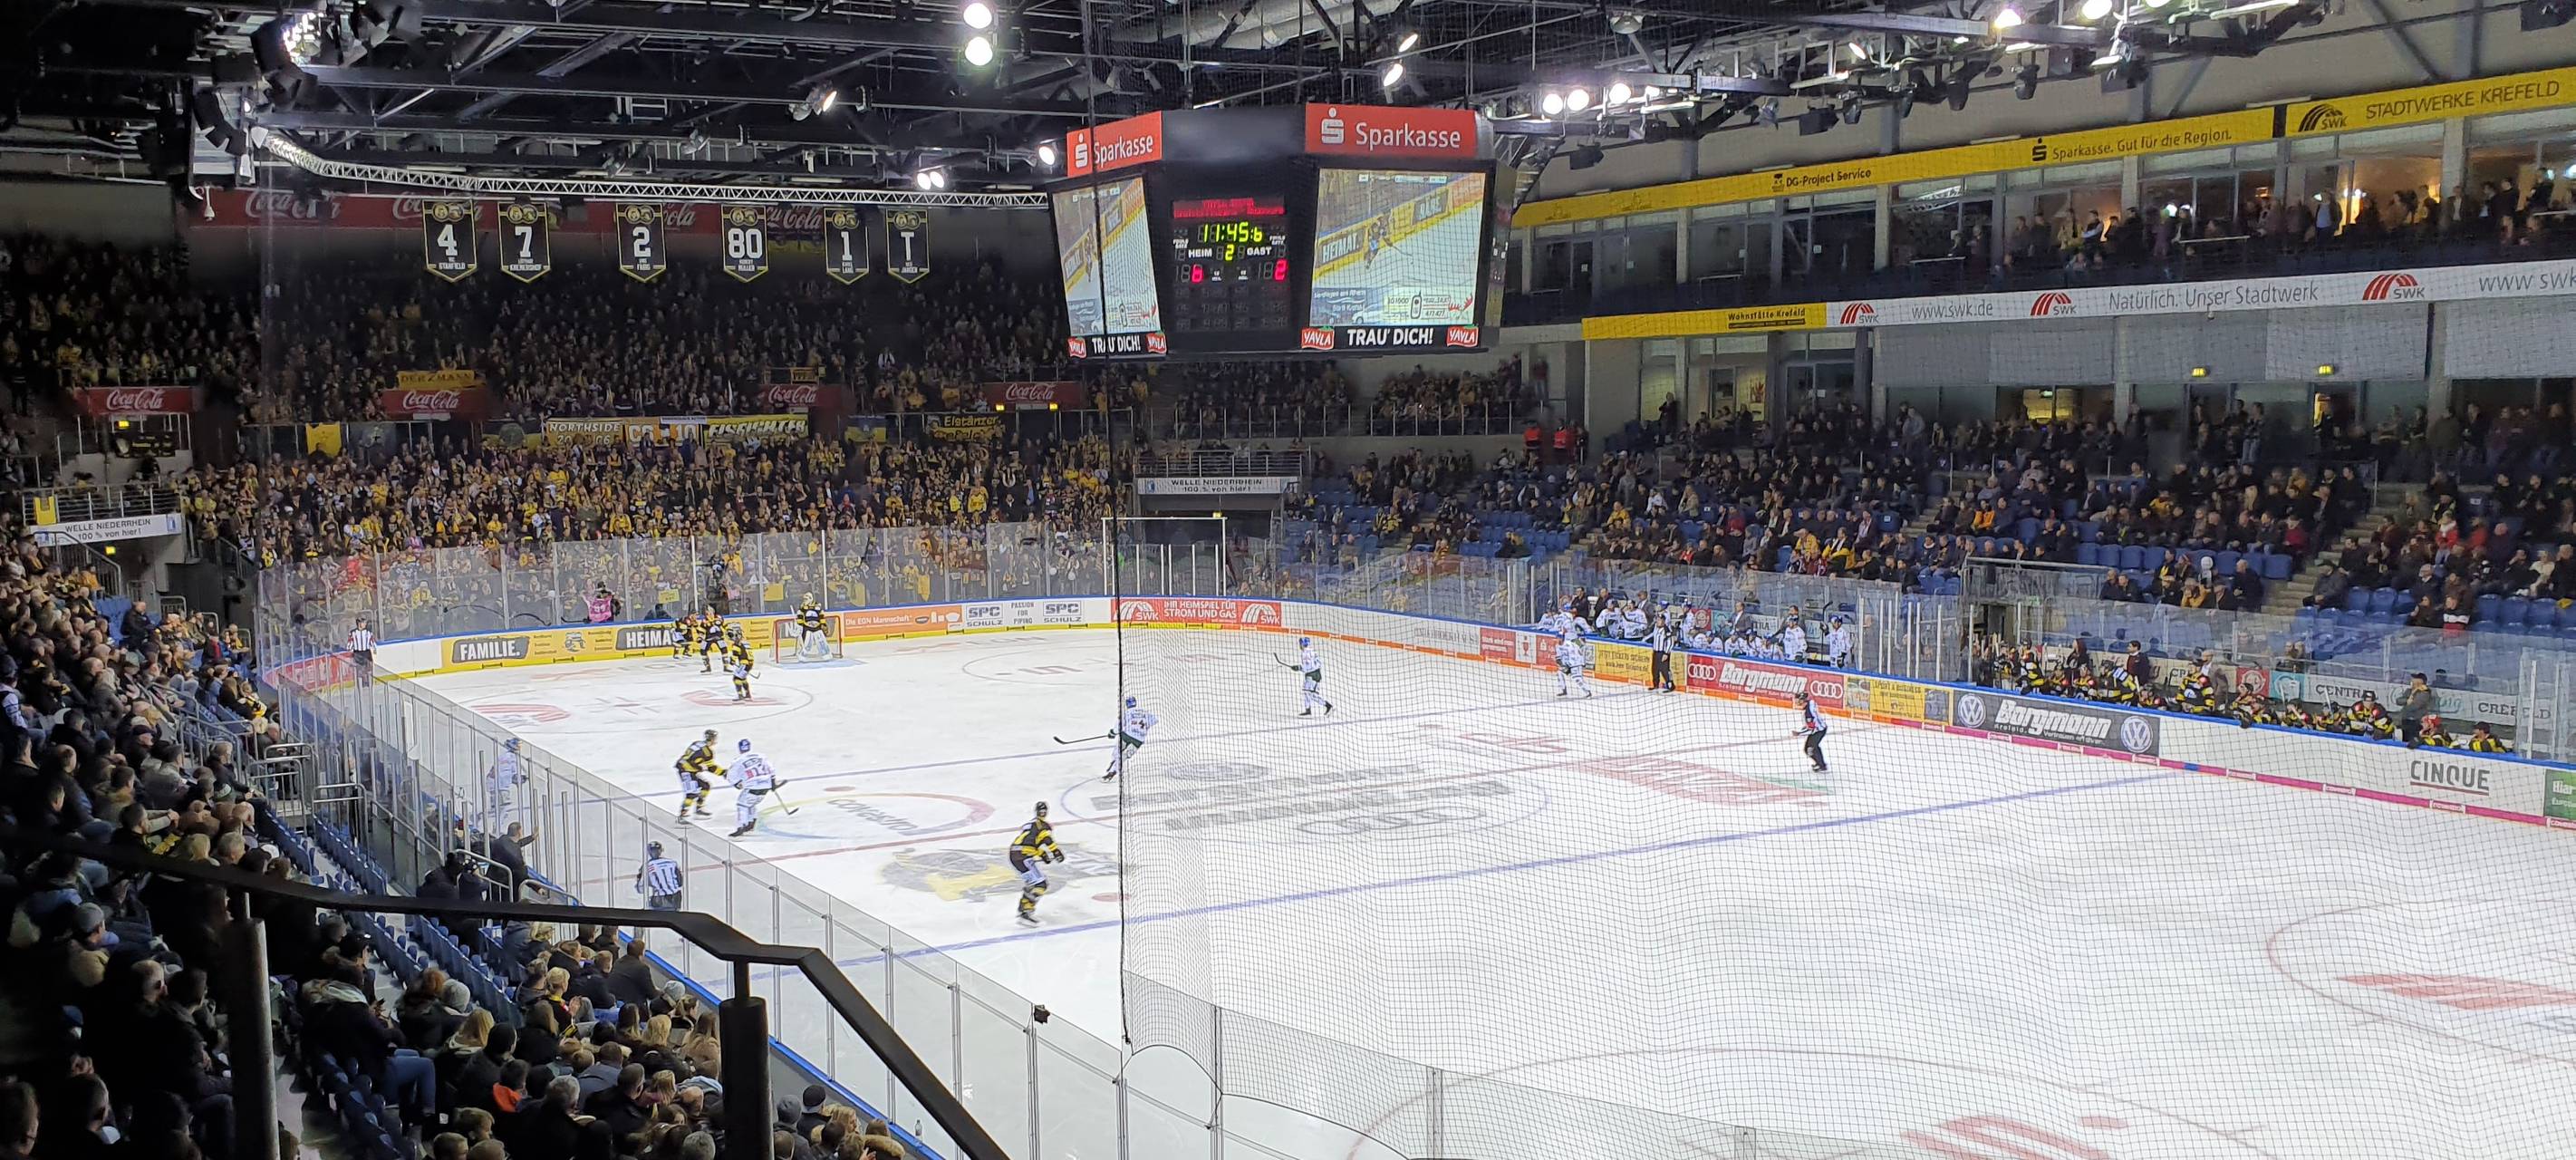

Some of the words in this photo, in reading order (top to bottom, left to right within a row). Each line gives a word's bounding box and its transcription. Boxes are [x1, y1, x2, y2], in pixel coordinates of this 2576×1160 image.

[2366, 92, 2475, 119] STADTWERKE
[2481, 81, 2559, 104] KREFELD
[2321, 116, 2347, 130] SWK
[1356, 122, 1461, 151] Sparkasse
[2053, 144, 2114, 162] Sparkasse.
[2118, 139, 2137, 152] Gut
[2141, 135, 2156, 149] für
[2162, 133, 2179, 147] die
[2184, 128, 2232, 146] Region.
[1094, 135, 1153, 168] Sparkasse
[1786, 173, 1835, 188] DG-Project
[1838, 169, 1871, 183] Service
[437, 225, 458, 256] 4
[515, 227, 532, 257] 7
[633, 227, 651, 257] 2
[728, 228, 763, 258] 80
[841, 231, 853, 261] 1
[901, 231, 914, 261] T
[1188, 248, 1212, 257] HEIM
[1225, 244, 1234, 261] 2
[1247, 246, 1271, 256] GAST
[1274, 258, 1288, 281] 2
[2109, 291, 2178, 312] Natürlich.
[2185, 287, 2231, 307] Unser
[2235, 282, 2319, 304] Stadtwerk
[2393, 286, 2425, 299] SWK
[1858, 314, 1878, 324] SWK
[1912, 300, 1993, 319] www.swk.de
[2053, 304, 2077, 315] SWK
[1118, 334, 1141, 352] DICH!
[1394, 327, 1433, 344] DICH!
[550, 422, 621, 432] NORTHSIDE
[65, 522, 93, 533] WELLE
[96, 518, 151, 530] NIEDERRHEIN
[78, 532, 93, 541] 100
[968, 605, 1000, 618] SPC
[1046, 603, 1079, 614] SPC
[1164, 609, 1196, 618] STROM
[1198, 609, 1217, 618] UND
[1219, 610, 1237, 619] GAS
[1180, 601, 1219, 610] HEIMSPIEL
[1136, 612, 1159, 621] SWK
[1260, 614, 1279, 624] SWK
[626, 628, 672, 648] HEIMA
[460, 639, 520, 661] FAMILIE.
[1719, 662, 1808, 693] Borgmann
[1995, 700, 2112, 739] Borgmann
[2410, 759, 2490, 791] CINQUE
